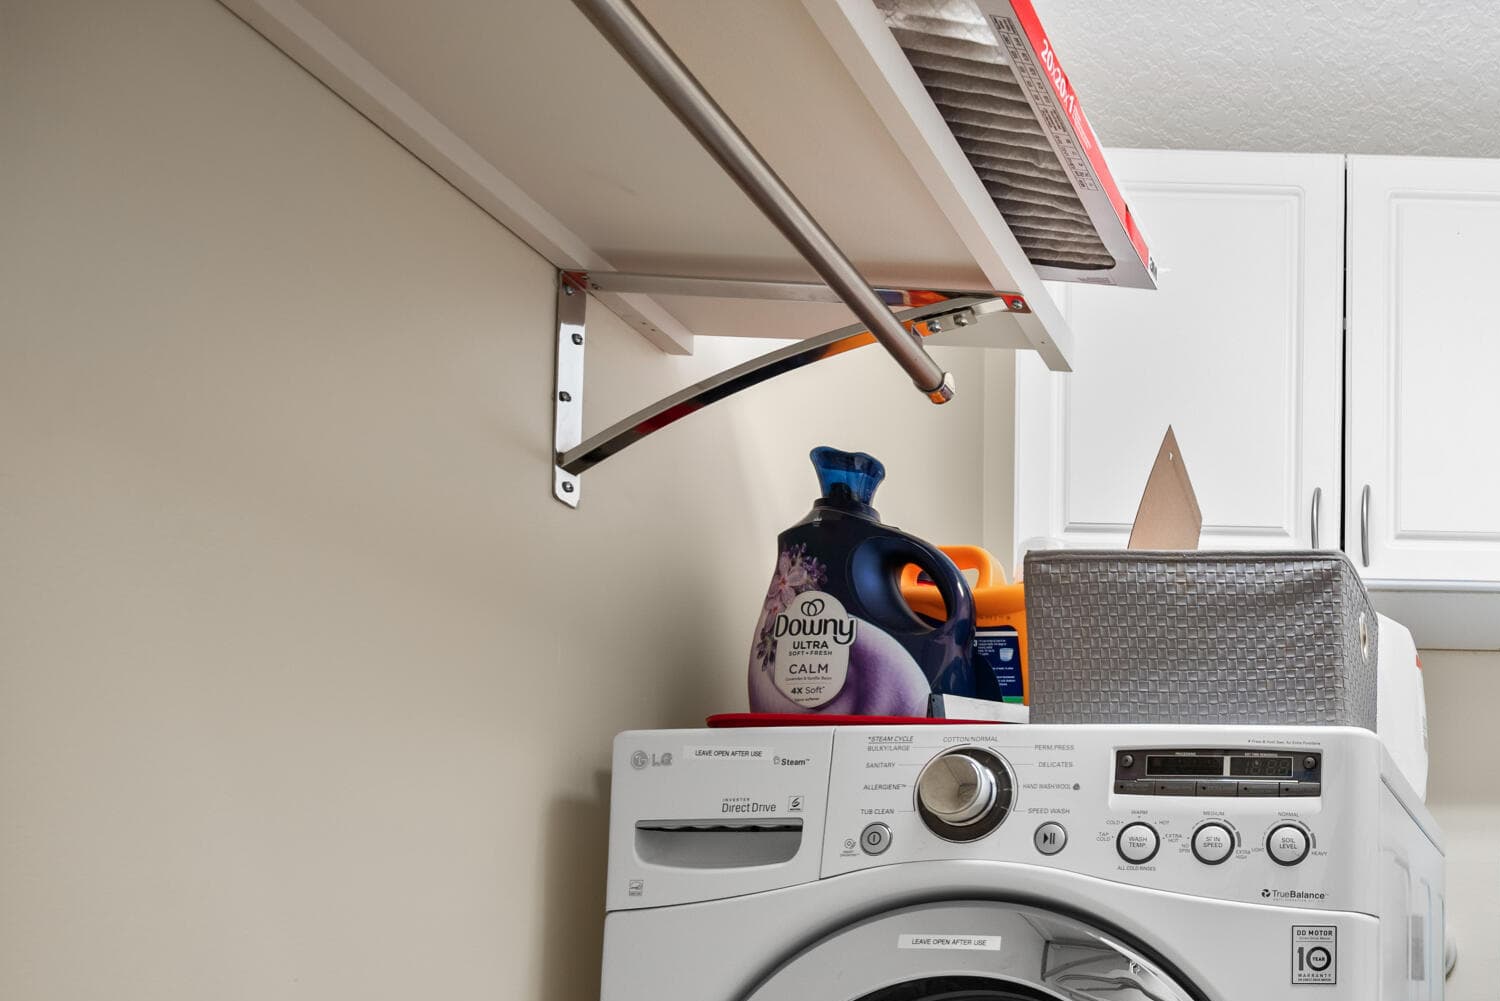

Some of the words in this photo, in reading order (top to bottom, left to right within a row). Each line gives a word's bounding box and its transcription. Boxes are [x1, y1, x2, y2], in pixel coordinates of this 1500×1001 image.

[1041, 39, 1074, 113] 20x20x1
[775, 614, 855, 645] Downy
[793, 641, 829, 649] ULTRA
[789, 663, 828, 674] CALM
[652, 752, 673, 767] LG
[721, 802, 750, 813] Direct
[751, 802, 776, 812] Drive
[1297, 946, 1332, 971] 10
